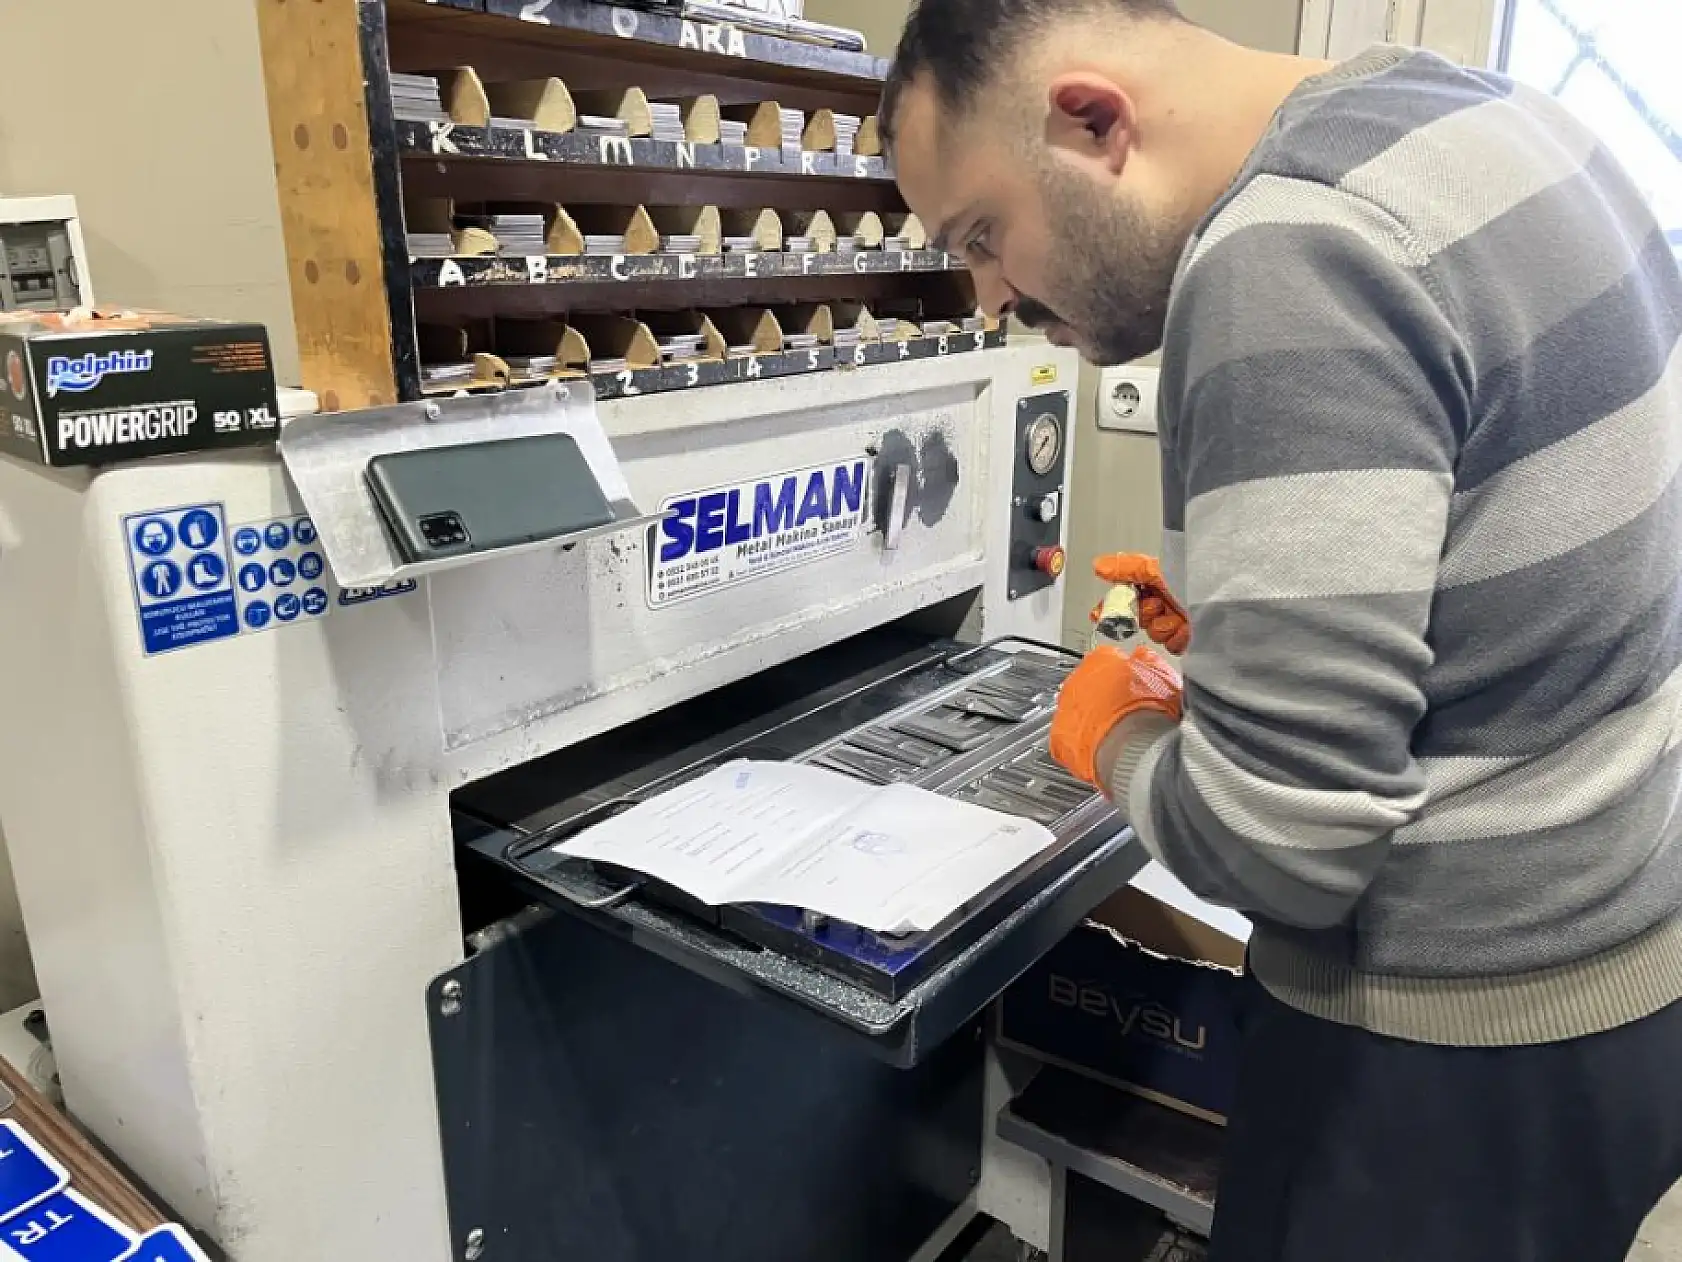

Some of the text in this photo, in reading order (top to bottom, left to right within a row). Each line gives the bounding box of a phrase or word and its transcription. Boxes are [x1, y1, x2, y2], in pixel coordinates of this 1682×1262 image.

[679, 20, 747, 58] ARA
[429, 120, 460, 155] K
[524, 129, 549, 160] L
[677, 142, 696, 169] N
[745, 147, 761, 171] P
[802, 151, 816, 175] R
[854, 156, 868, 178] S
[438, 258, 466, 287] A
[526, 255, 549, 284] B
[611, 255, 630, 281] C
[745, 254, 758, 277] E
[803, 253, 814, 275] F
[853, 252, 868, 273] G
[901, 251, 913, 271] H
[46, 349, 153, 386] Dolphin
[616, 369, 642, 395] 2
[687, 363, 700, 387] 3
[746, 356, 762, 378] 4
[808, 350, 820, 369] 5
[854, 343, 866, 364] 6
[938, 335, 949, 354] 8
[974, 329, 986, 349] 9
[57, 404, 198, 450] POWERGRIP
[213, 407, 277, 429] 50 XL
[660, 461, 864, 563] SELMAN
[10, 1210, 74, 1245] TR
